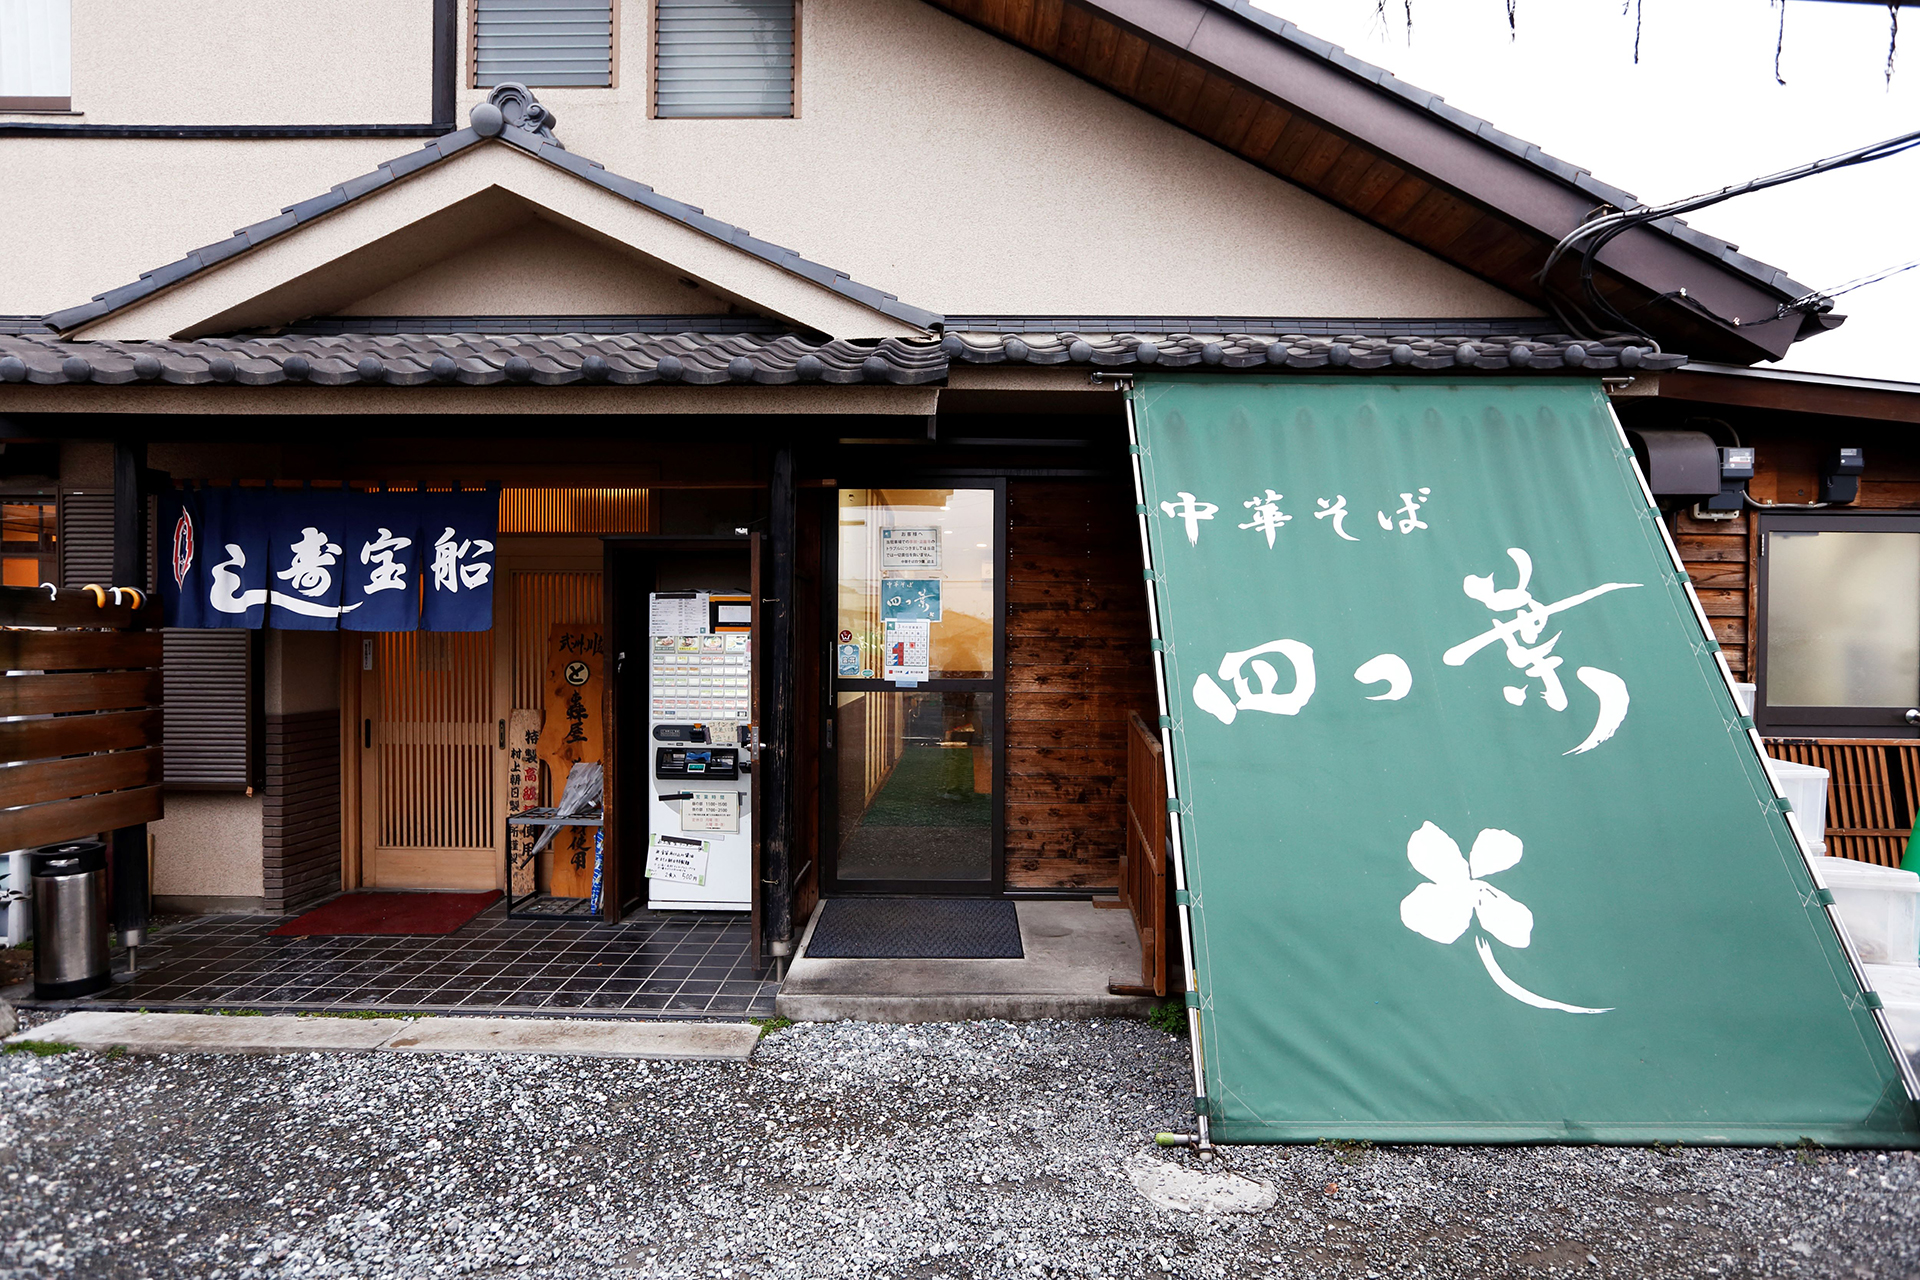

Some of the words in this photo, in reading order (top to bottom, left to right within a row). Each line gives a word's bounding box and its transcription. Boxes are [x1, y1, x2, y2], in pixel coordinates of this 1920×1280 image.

[1160, 487, 1431, 550] 中華そば
[886, 588, 936, 613] 四つ葉
[1192, 547, 1645, 756] 四つ葉
